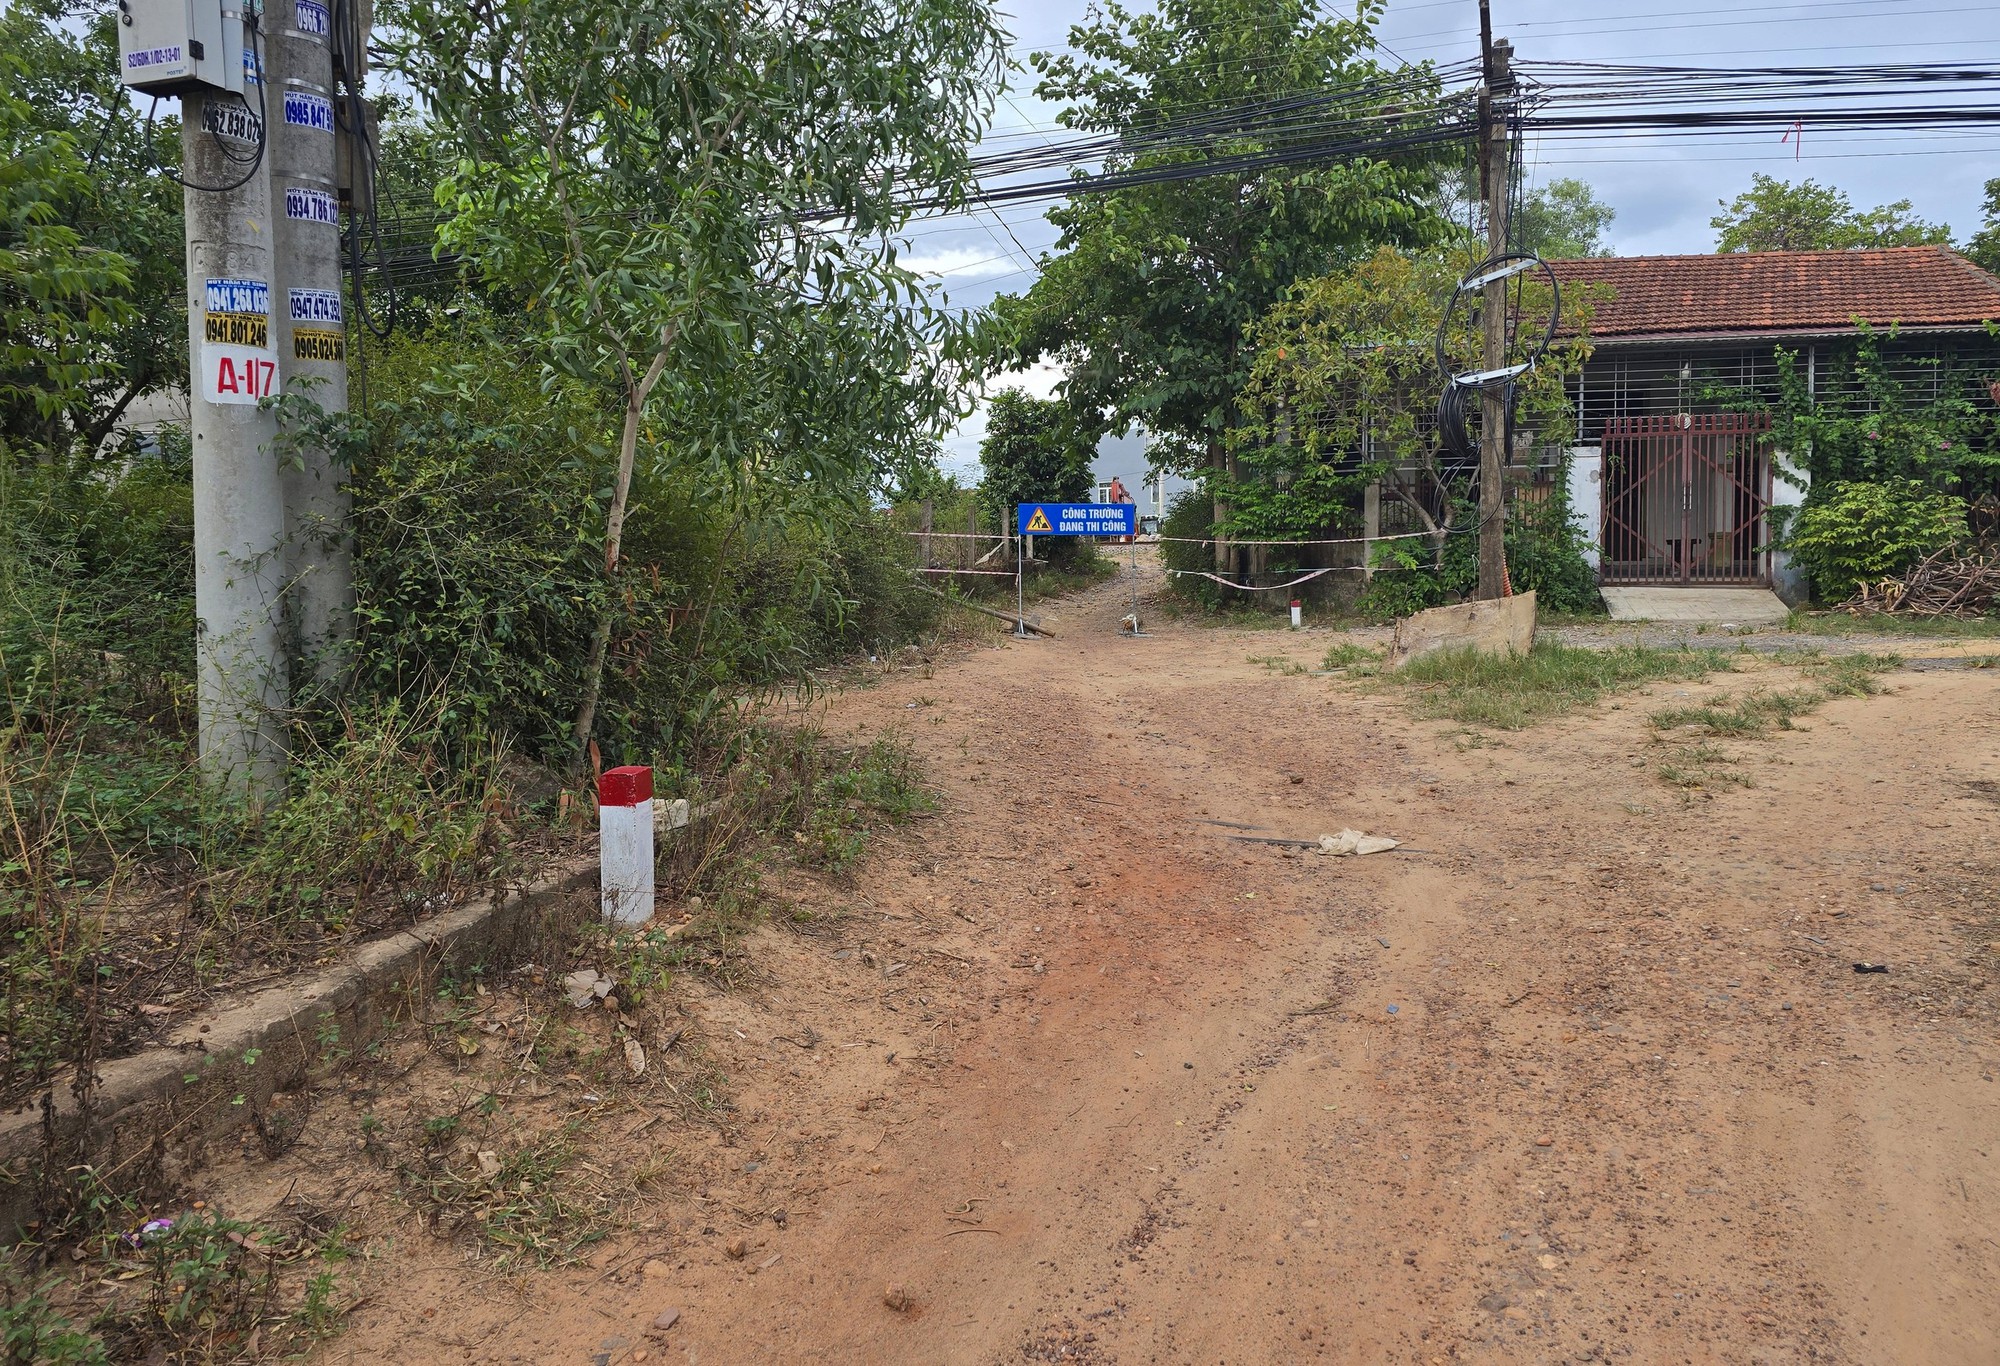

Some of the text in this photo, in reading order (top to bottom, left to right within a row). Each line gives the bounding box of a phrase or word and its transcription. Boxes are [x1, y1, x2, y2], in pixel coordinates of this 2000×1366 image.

[287, 195, 337, 224] 0934.786.123
[207, 318, 266, 347] 0941.801.246
[1062, 506, 1123, 519] CÔNG TRƯỜNG
[1059, 520, 1126, 531] ĐANG THI CÔNG
